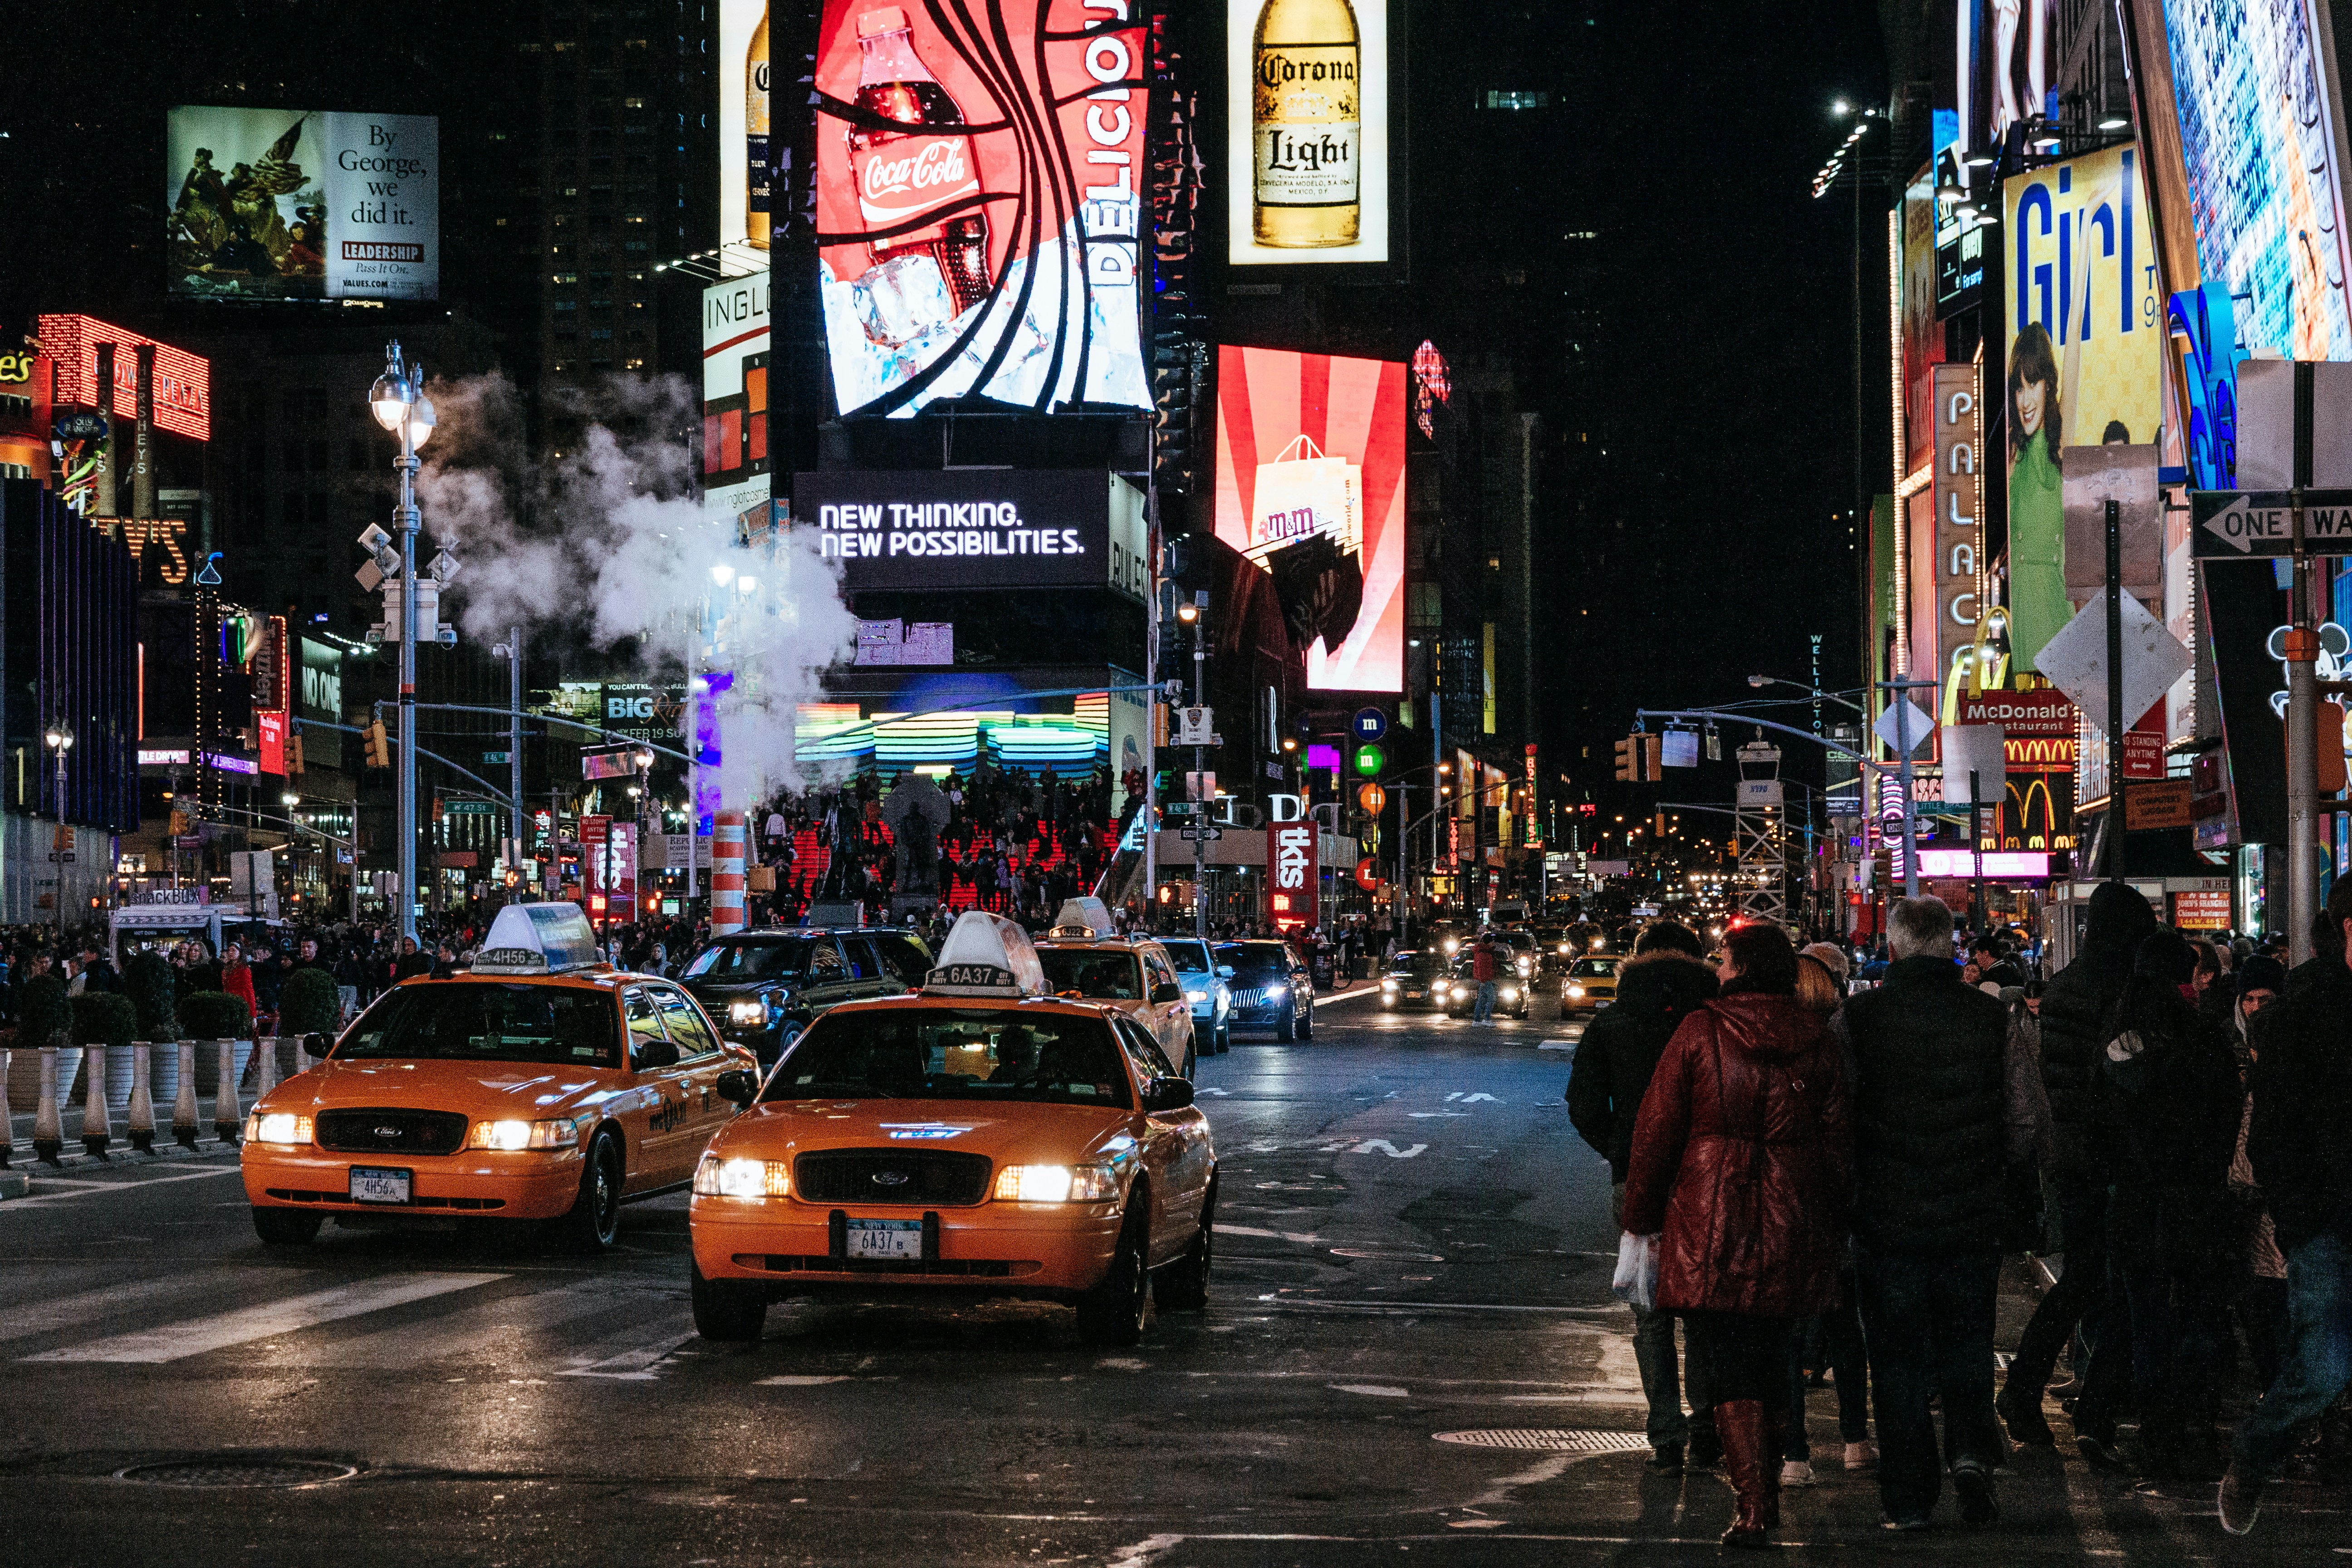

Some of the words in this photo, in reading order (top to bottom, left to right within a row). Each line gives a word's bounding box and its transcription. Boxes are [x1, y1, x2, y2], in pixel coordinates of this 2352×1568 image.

[1260, 53, 1355, 90] Corona
[368, 125, 396, 151] By
[1268, 130, 1349, 171] Light
[338, 149, 427, 178] George,
[367, 183, 397, 196] we
[352, 202, 387, 225] did
[393, 204, 413, 225] it.
[345, 244, 419, 260] LEADERSHIP
[2017, 150, 2133, 346] Girl
[343, 279, 388, 288] VALUES.COM
[708, 286, 769, 328] INGL
[820, 505, 882, 529] NEW
[888, 502, 1023, 527] THINKING.
[2225, 511, 2283, 536] ONE
[820, 533, 882, 557] NEW
[889, 529, 1085, 556] POSSIBILITIES.
[1950, 392, 1975, 675] PALACE
[608, 697, 653, 718] BIG
[1967, 704, 2073, 719] McDonald'
[630, 729, 650, 738] FEB
[652, 729, 663, 738] 19
[2132, 737, 2161, 747] STANDING
[2126, 749, 2156, 759] ANYTIME
[1279, 827, 1311, 888] tkts
[132, 887, 200, 904] snackBOX
[493, 950, 526, 964] 4H56
[951, 966, 994, 984] 6A37
[364, 1179, 389, 1194] 4H56
[861, 1230, 893, 1250] 6A37
[896, 1240, 904, 1250] B
